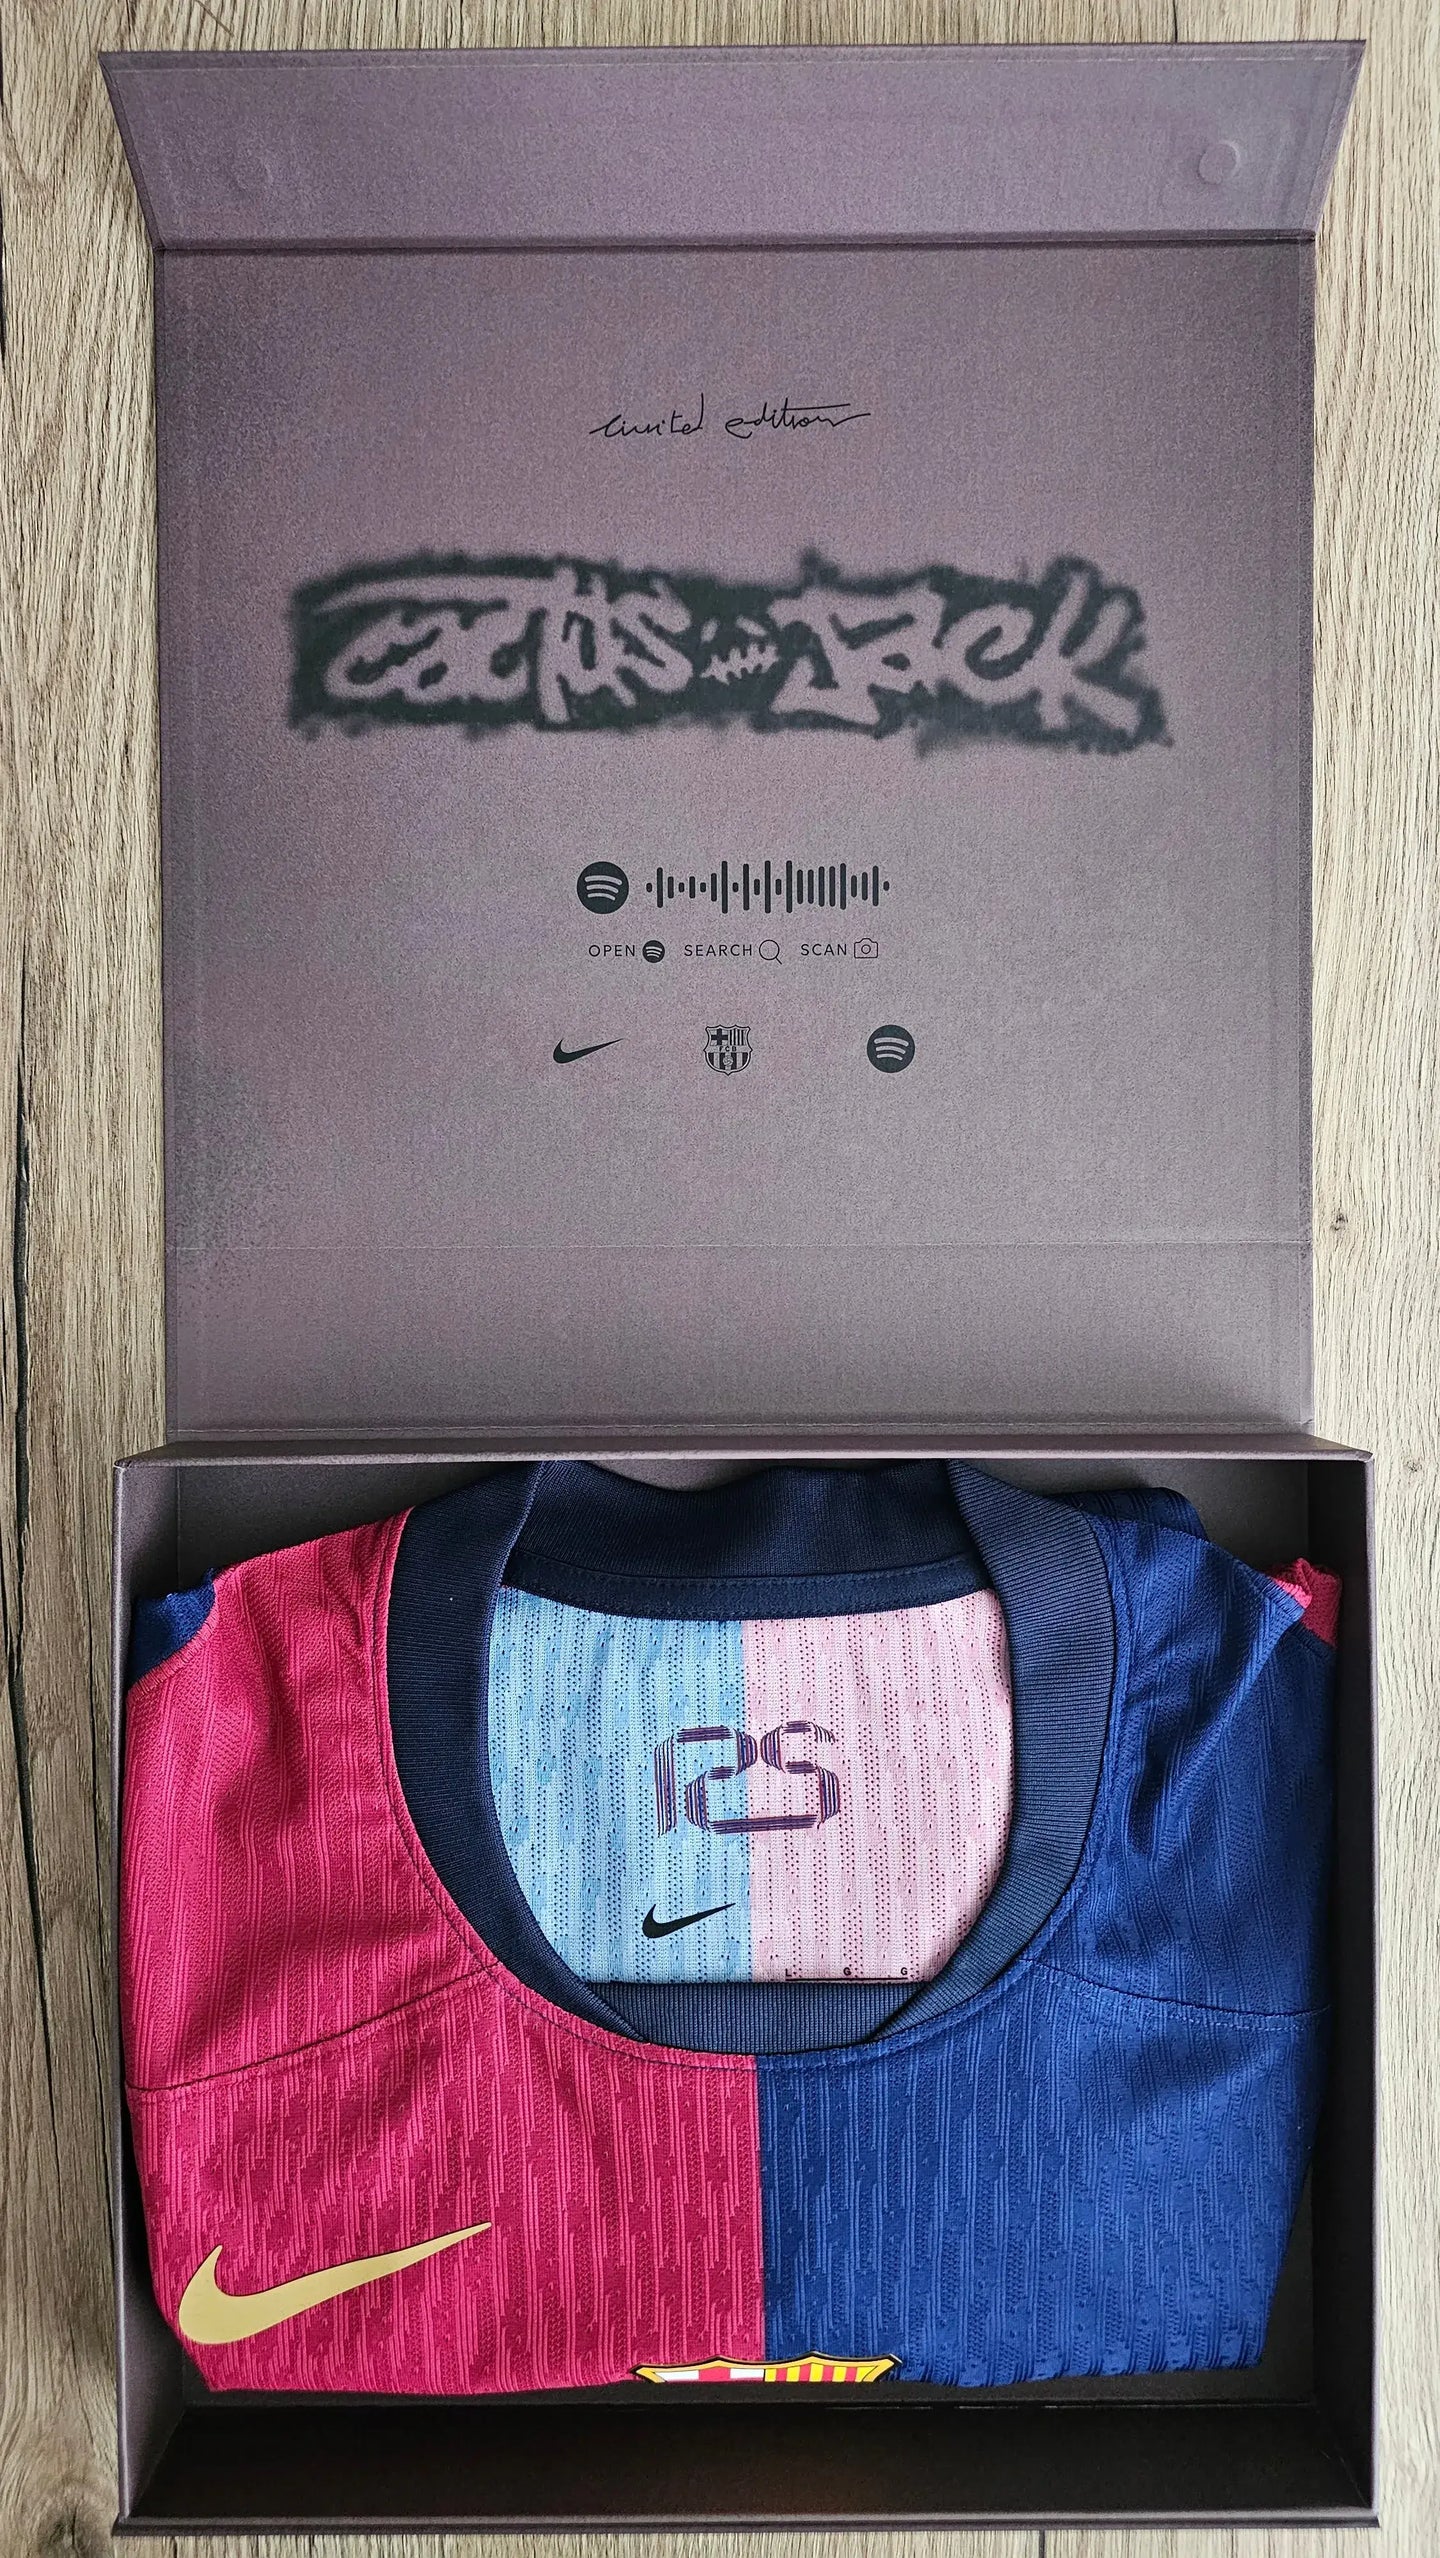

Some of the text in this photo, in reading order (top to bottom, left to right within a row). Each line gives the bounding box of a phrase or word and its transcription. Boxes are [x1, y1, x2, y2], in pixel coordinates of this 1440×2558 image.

[725, 397, 871, 439] edition
[588, 943, 848, 957] OPEN SEARCH SCAN
[719, 1045, 737, 1053] FCB
